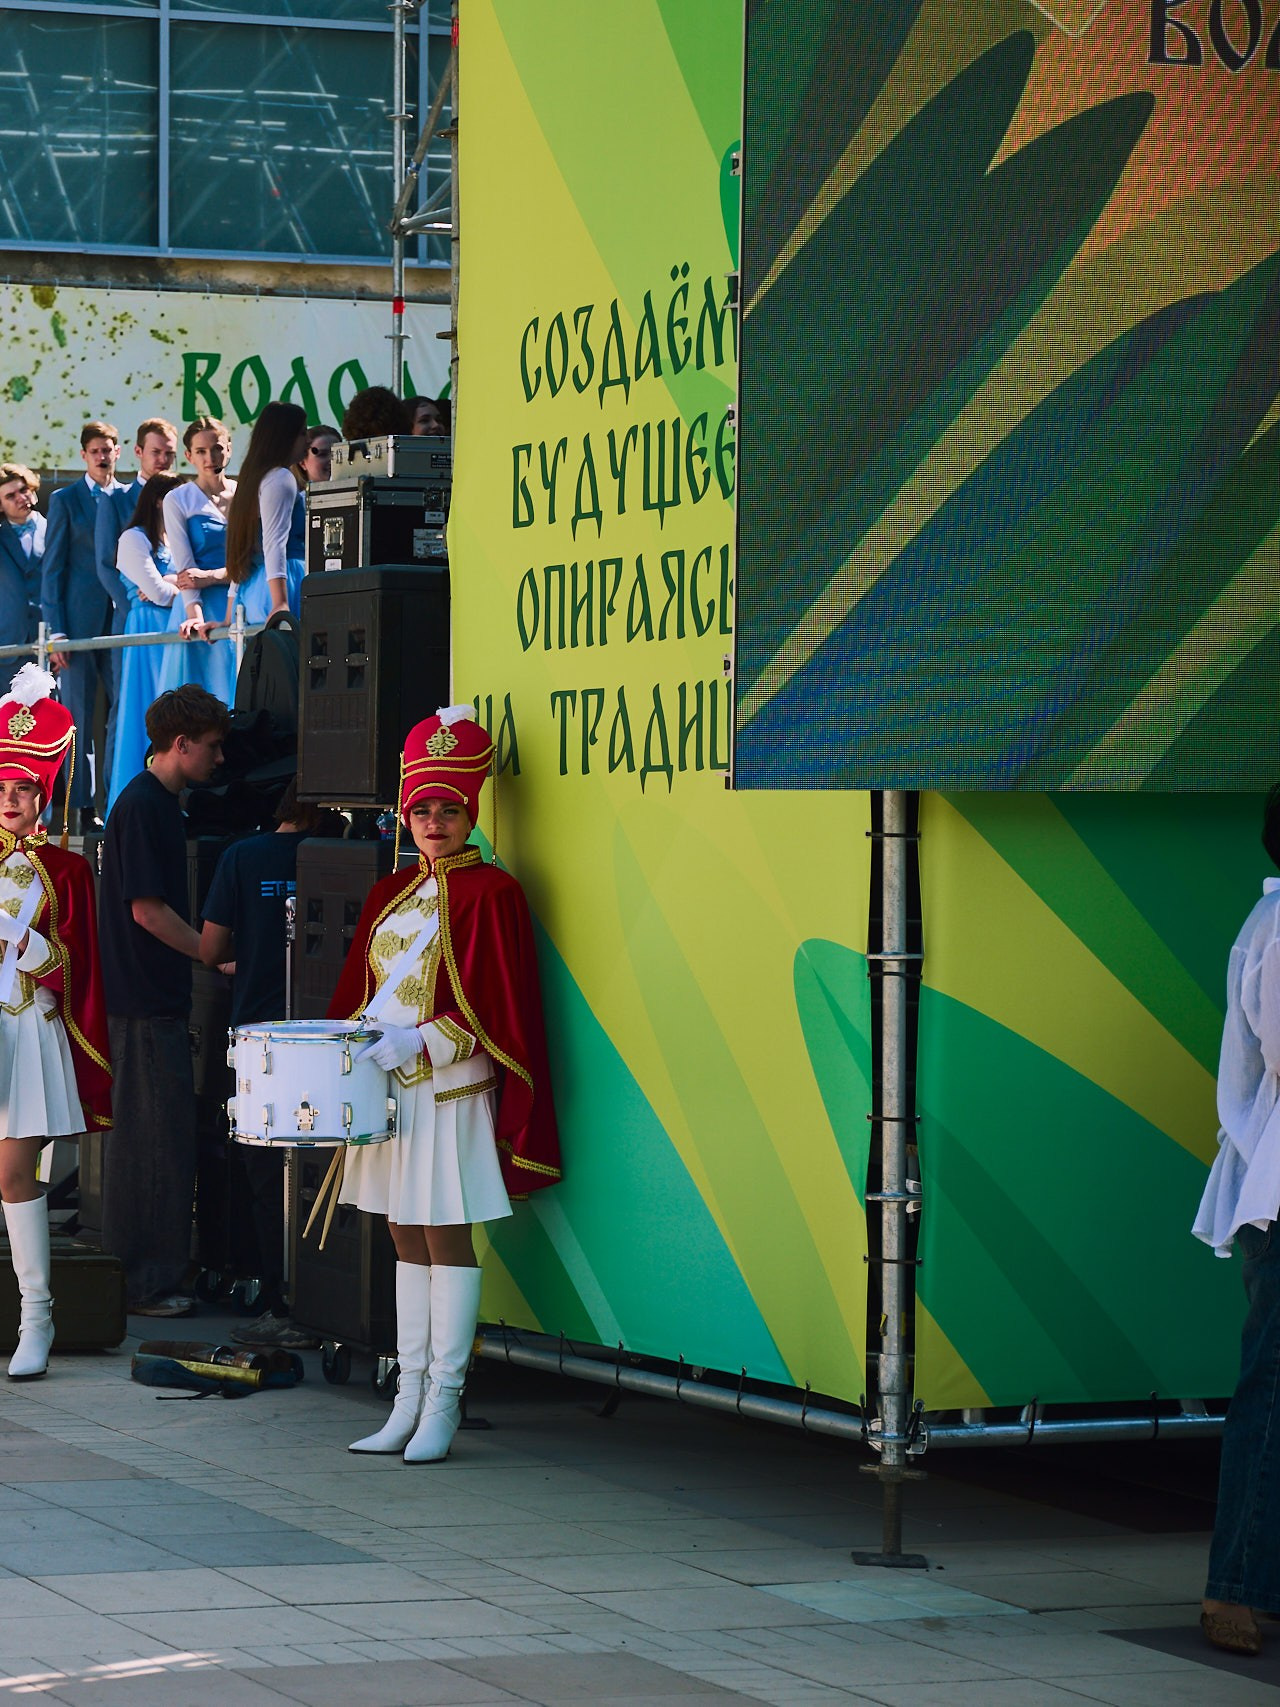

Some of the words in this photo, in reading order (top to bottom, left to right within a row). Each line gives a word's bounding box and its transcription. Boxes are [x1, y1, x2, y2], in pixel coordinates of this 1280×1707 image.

[1148, 0, 1280, 72] ВО
[520, 261, 737, 410] СОЗДАЁМ
[512, 412, 735, 542] БУДУЩЕЕ
